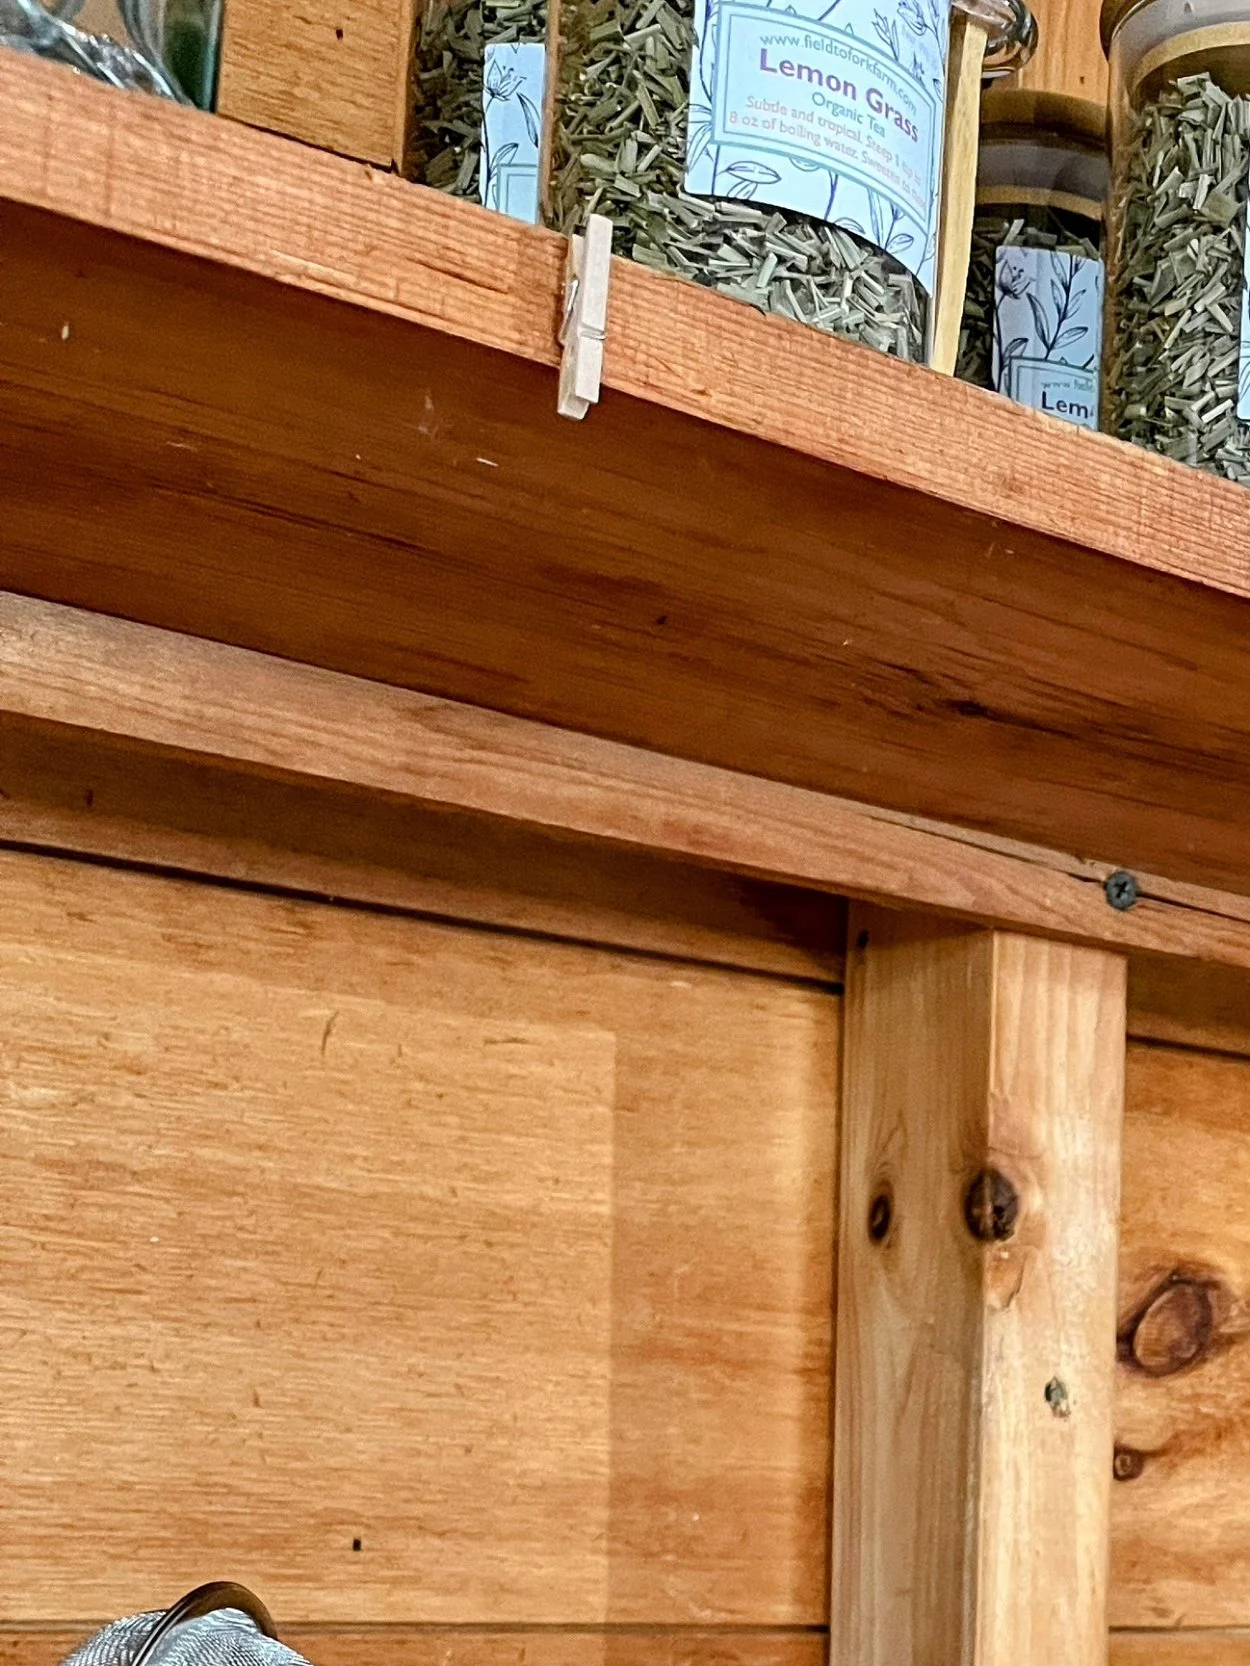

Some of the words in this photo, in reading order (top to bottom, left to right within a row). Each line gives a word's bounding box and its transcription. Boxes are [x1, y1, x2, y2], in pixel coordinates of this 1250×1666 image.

[759, 35, 917, 116] www.fieldtoforkfarm.com
[760, 48, 857, 101] Lemon
[866, 87, 919, 143] Grass
[729, 112, 737, 124] 8
[742, 116, 758, 127] oz
[762, 116, 777, 130] of
[780, 121, 821, 147] boiling
[792, 109, 814, 124] and
[812, 92, 863, 124] Organic
[867, 114, 886, 138] Tea
[1042, 390, 1094, 419] Lem
